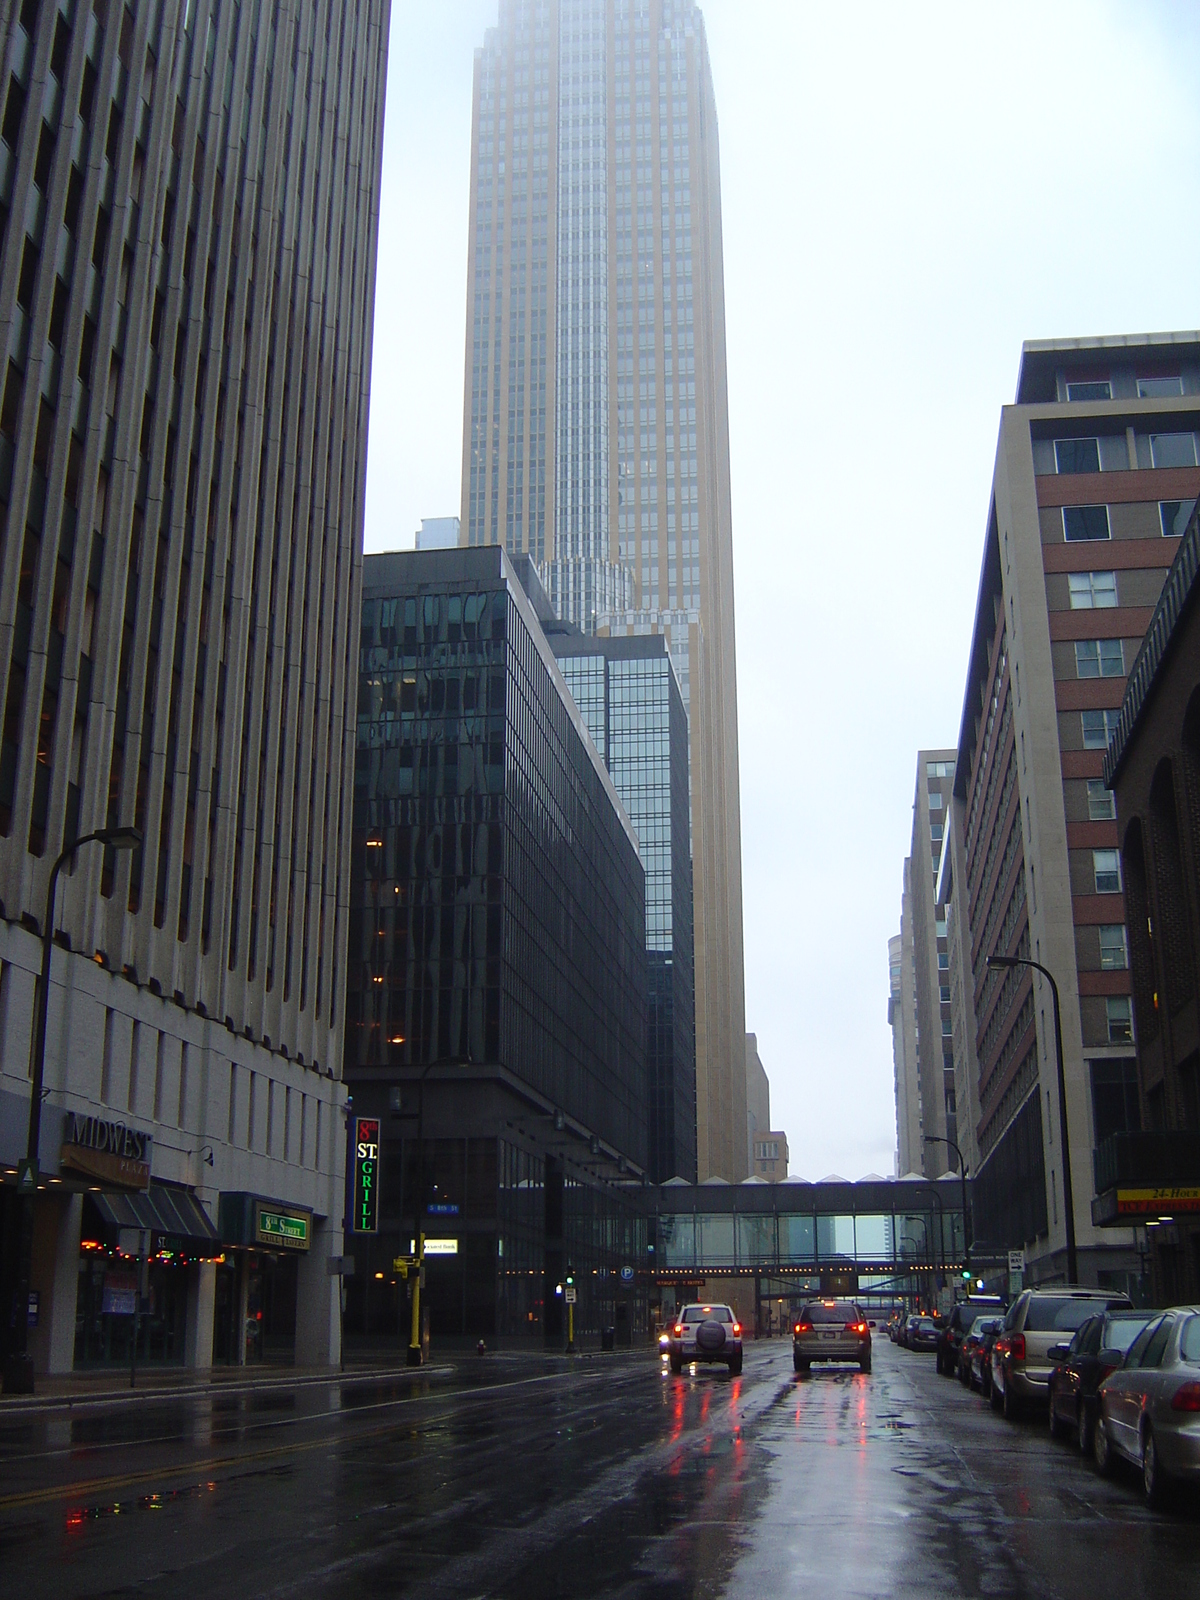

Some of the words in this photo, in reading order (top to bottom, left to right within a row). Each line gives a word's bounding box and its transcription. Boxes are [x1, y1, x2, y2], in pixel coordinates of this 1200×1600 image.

[67, 1112, 152, 1161] MIDWEST
[360, 1121, 378, 1141] 8th
[358, 1143, 378, 1160] ST.
[120, 1160, 149, 1175] PLAZA
[361, 1161, 374, 1230] GRILL
